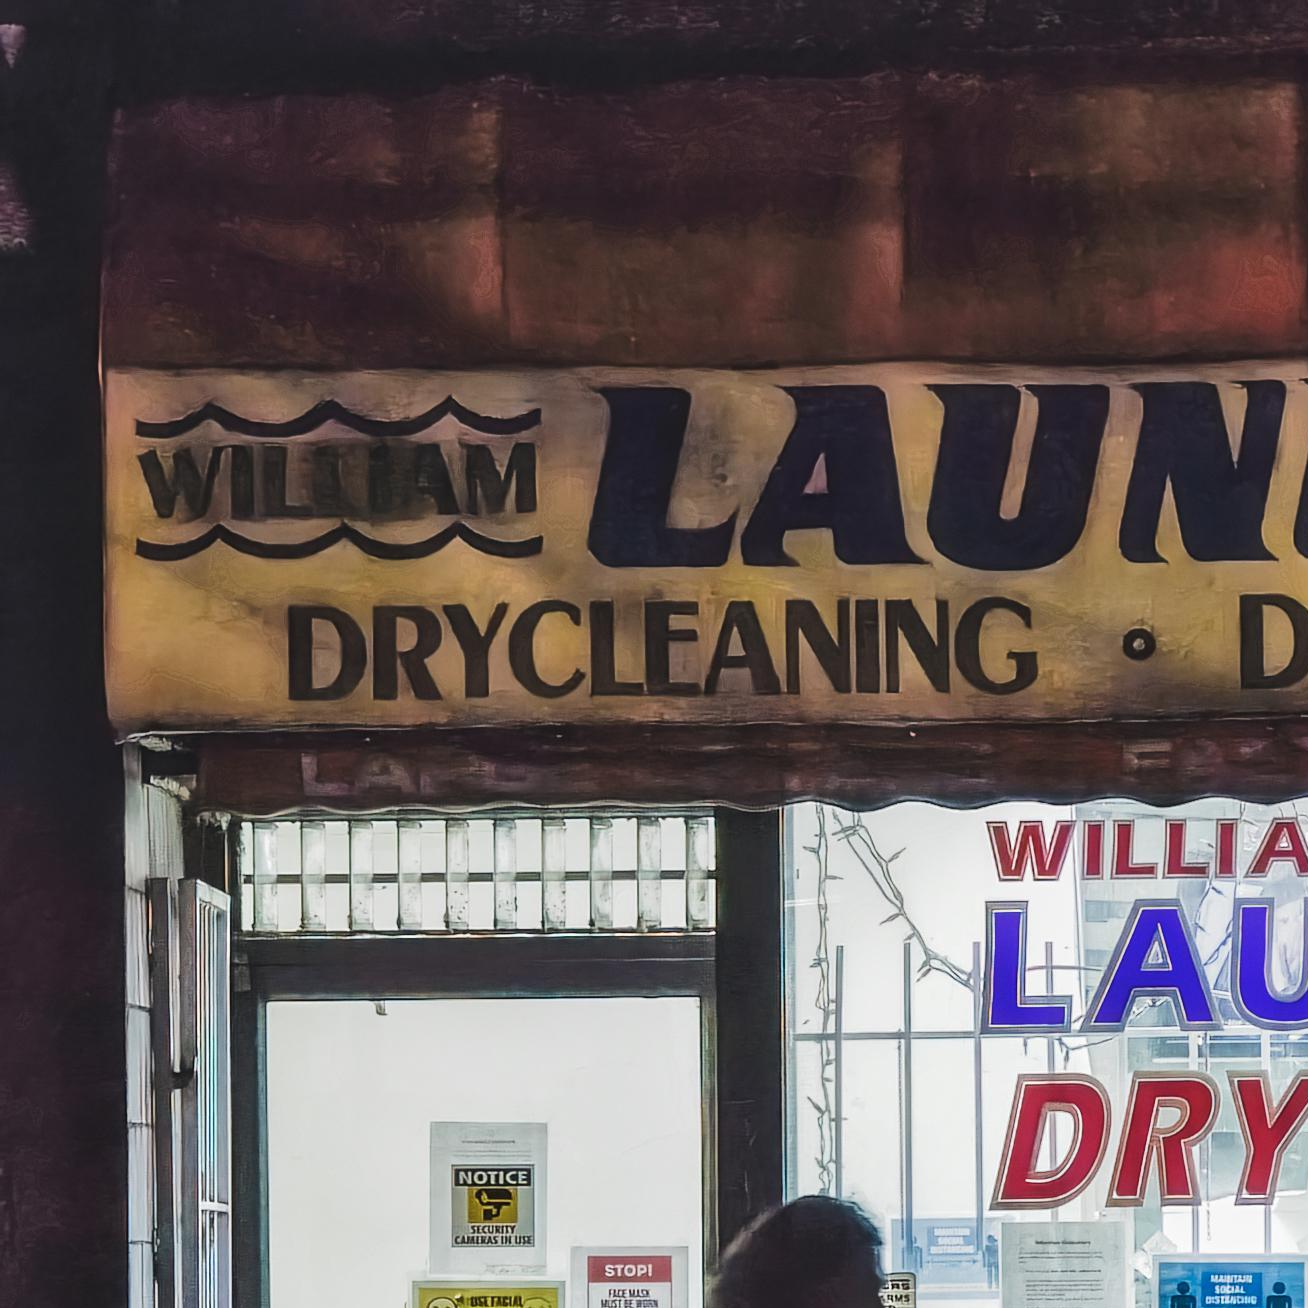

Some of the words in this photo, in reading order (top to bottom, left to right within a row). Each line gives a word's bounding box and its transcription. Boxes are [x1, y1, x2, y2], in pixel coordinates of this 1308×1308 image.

[136, 441, 539, 519] WILLIAM
[286, 595, 1038, 702] DRYCLEANING
[459, 1171, 528, 1184] NOTICE
[471, 1225, 516, 1234] SECURITY
[454, 1235, 499, 1245] CAMERAS
[501, 1236, 513, 1245] IN
[516, 1235, 532, 1245] USE
[604, 1264, 653, 1277] STOP!
[1210, 1274, 1253, 1284] MAINTAIN
[608, 1288, 627, 1298] FACE
[629, 1288, 651, 1298] MASK
[1214, 1285, 1246, 1294] SOCIAL
[601, 1299, 622, 1308] MUST
